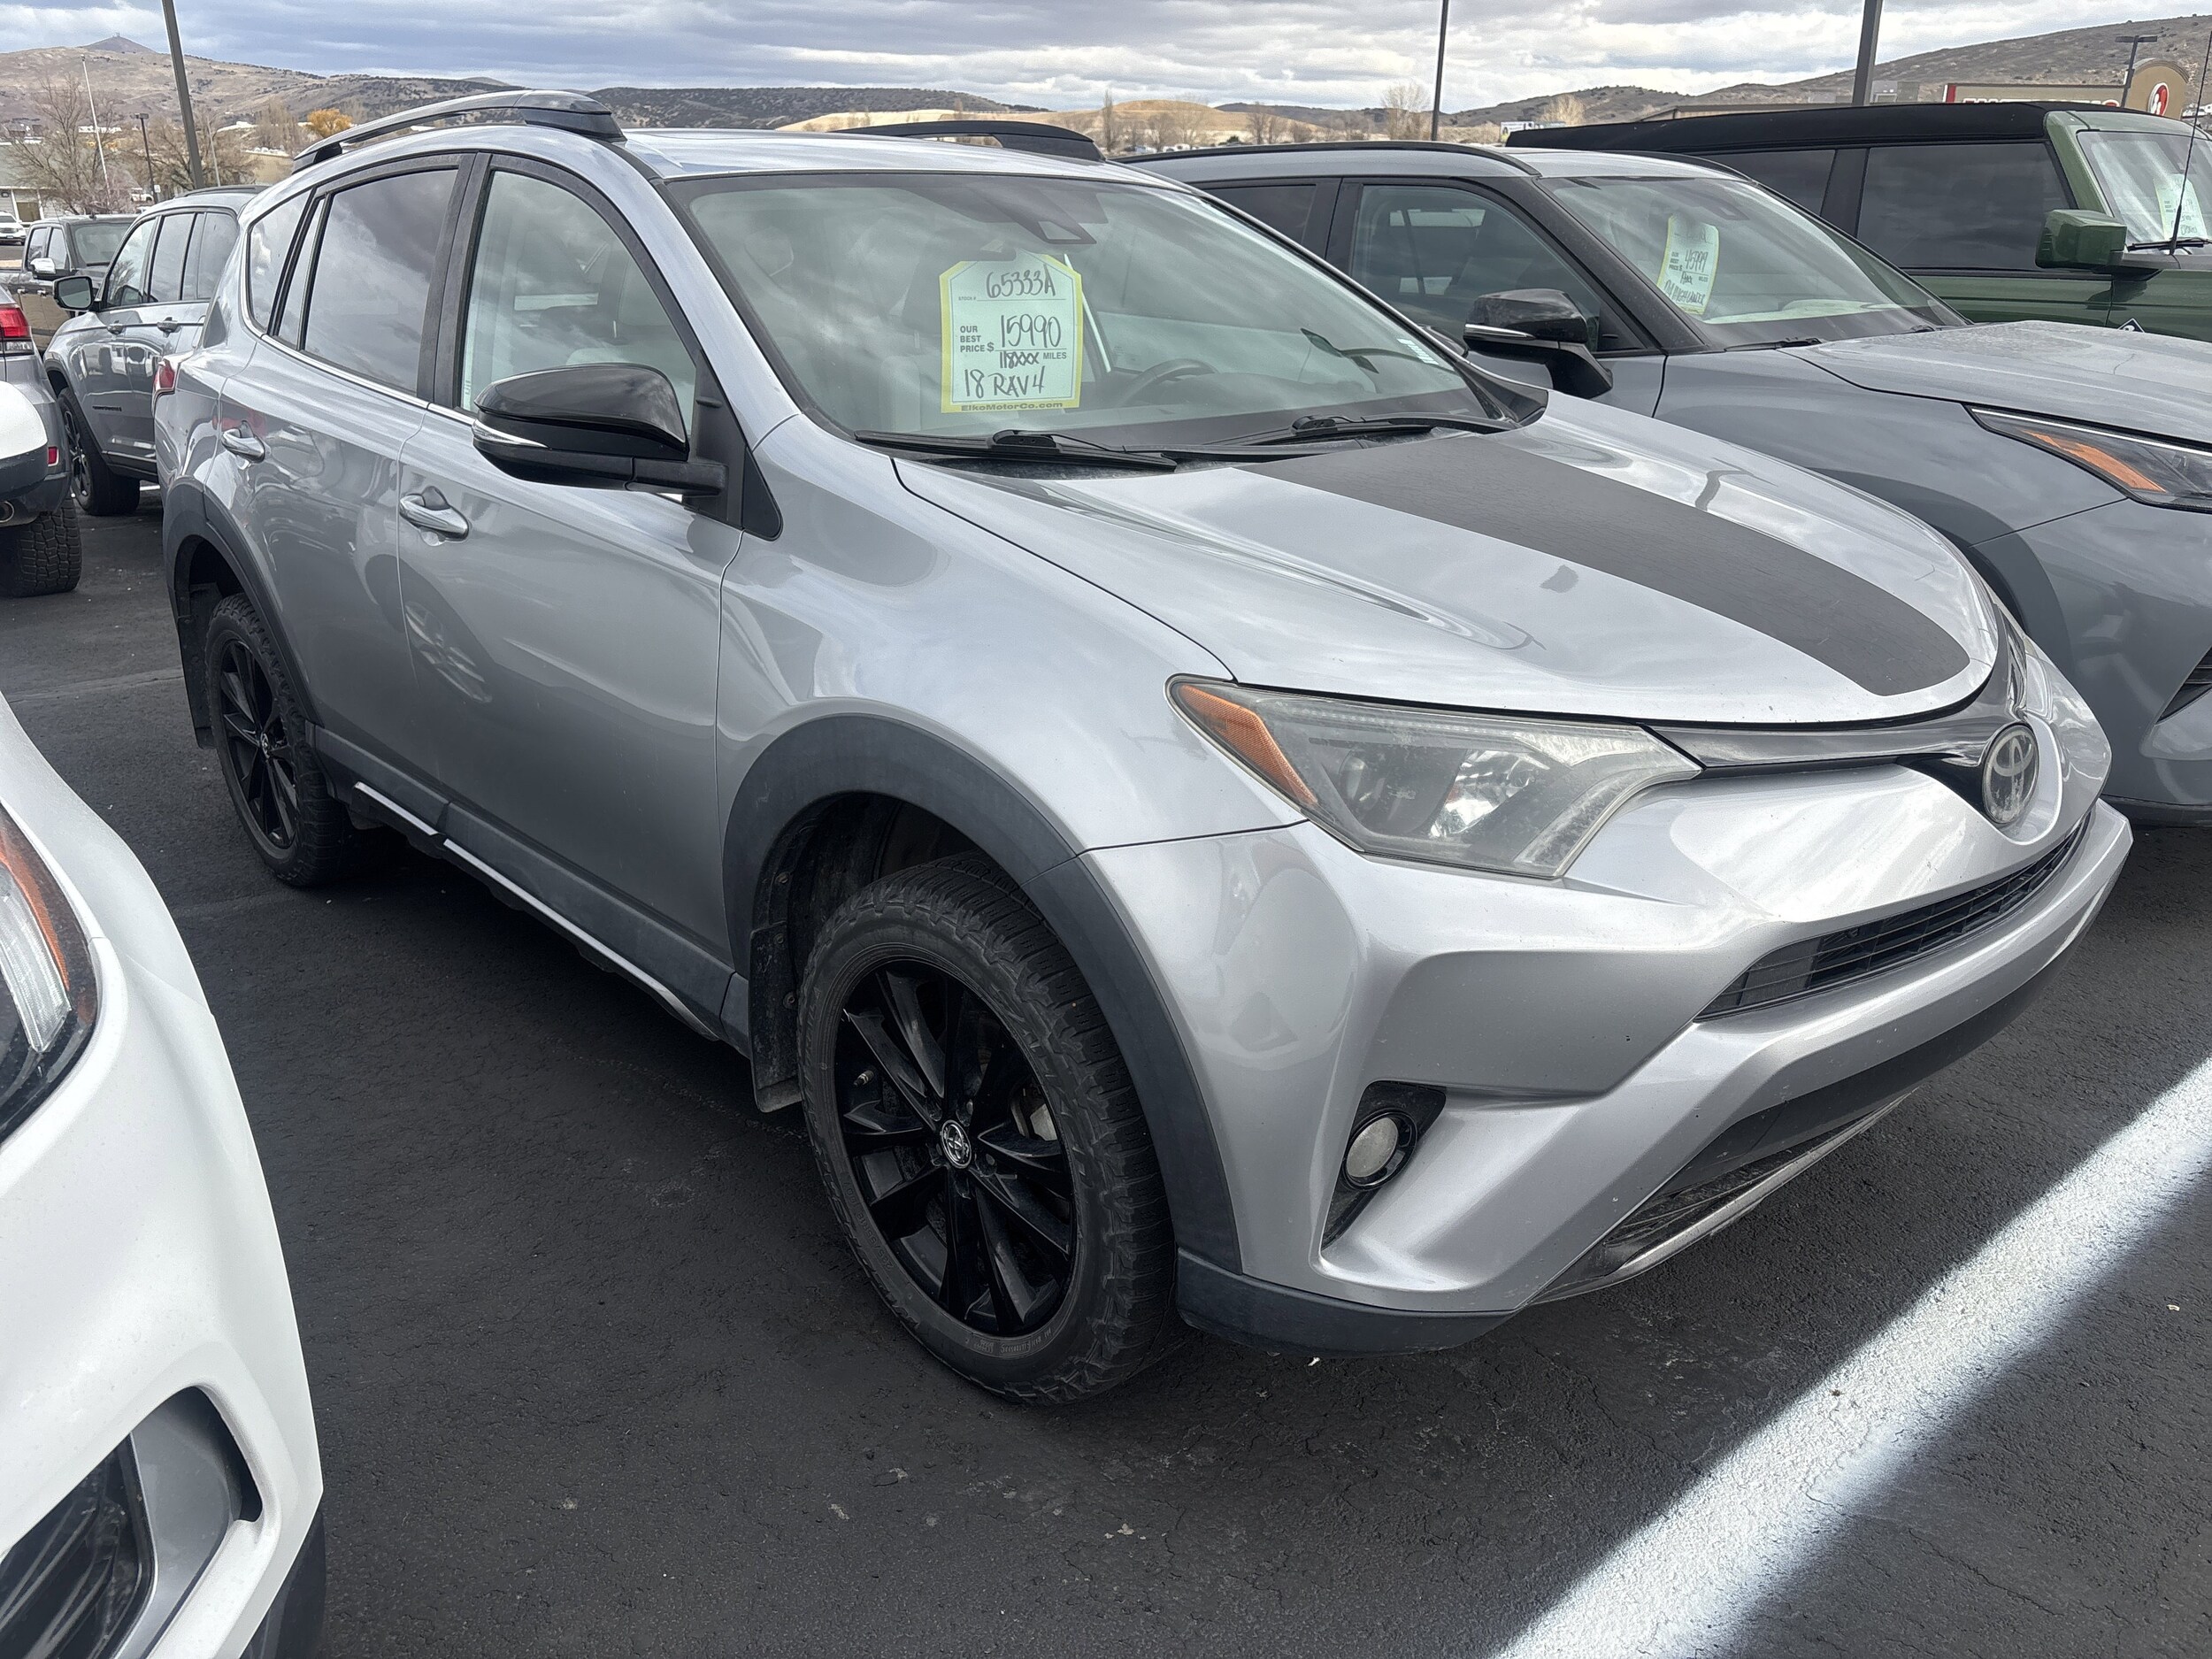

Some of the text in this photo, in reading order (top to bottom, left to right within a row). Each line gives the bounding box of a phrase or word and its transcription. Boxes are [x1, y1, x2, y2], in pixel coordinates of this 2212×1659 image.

[986, 264, 1056, 299] 65333A
[959, 325, 979, 334] OUR
[959, 313, 1062, 354] PRICE $ 15990
[959, 334, 982, 343] BEST
[964, 368, 985, 399] 18
[961, 401, 1064, 412] ElkoMotorCo.com
